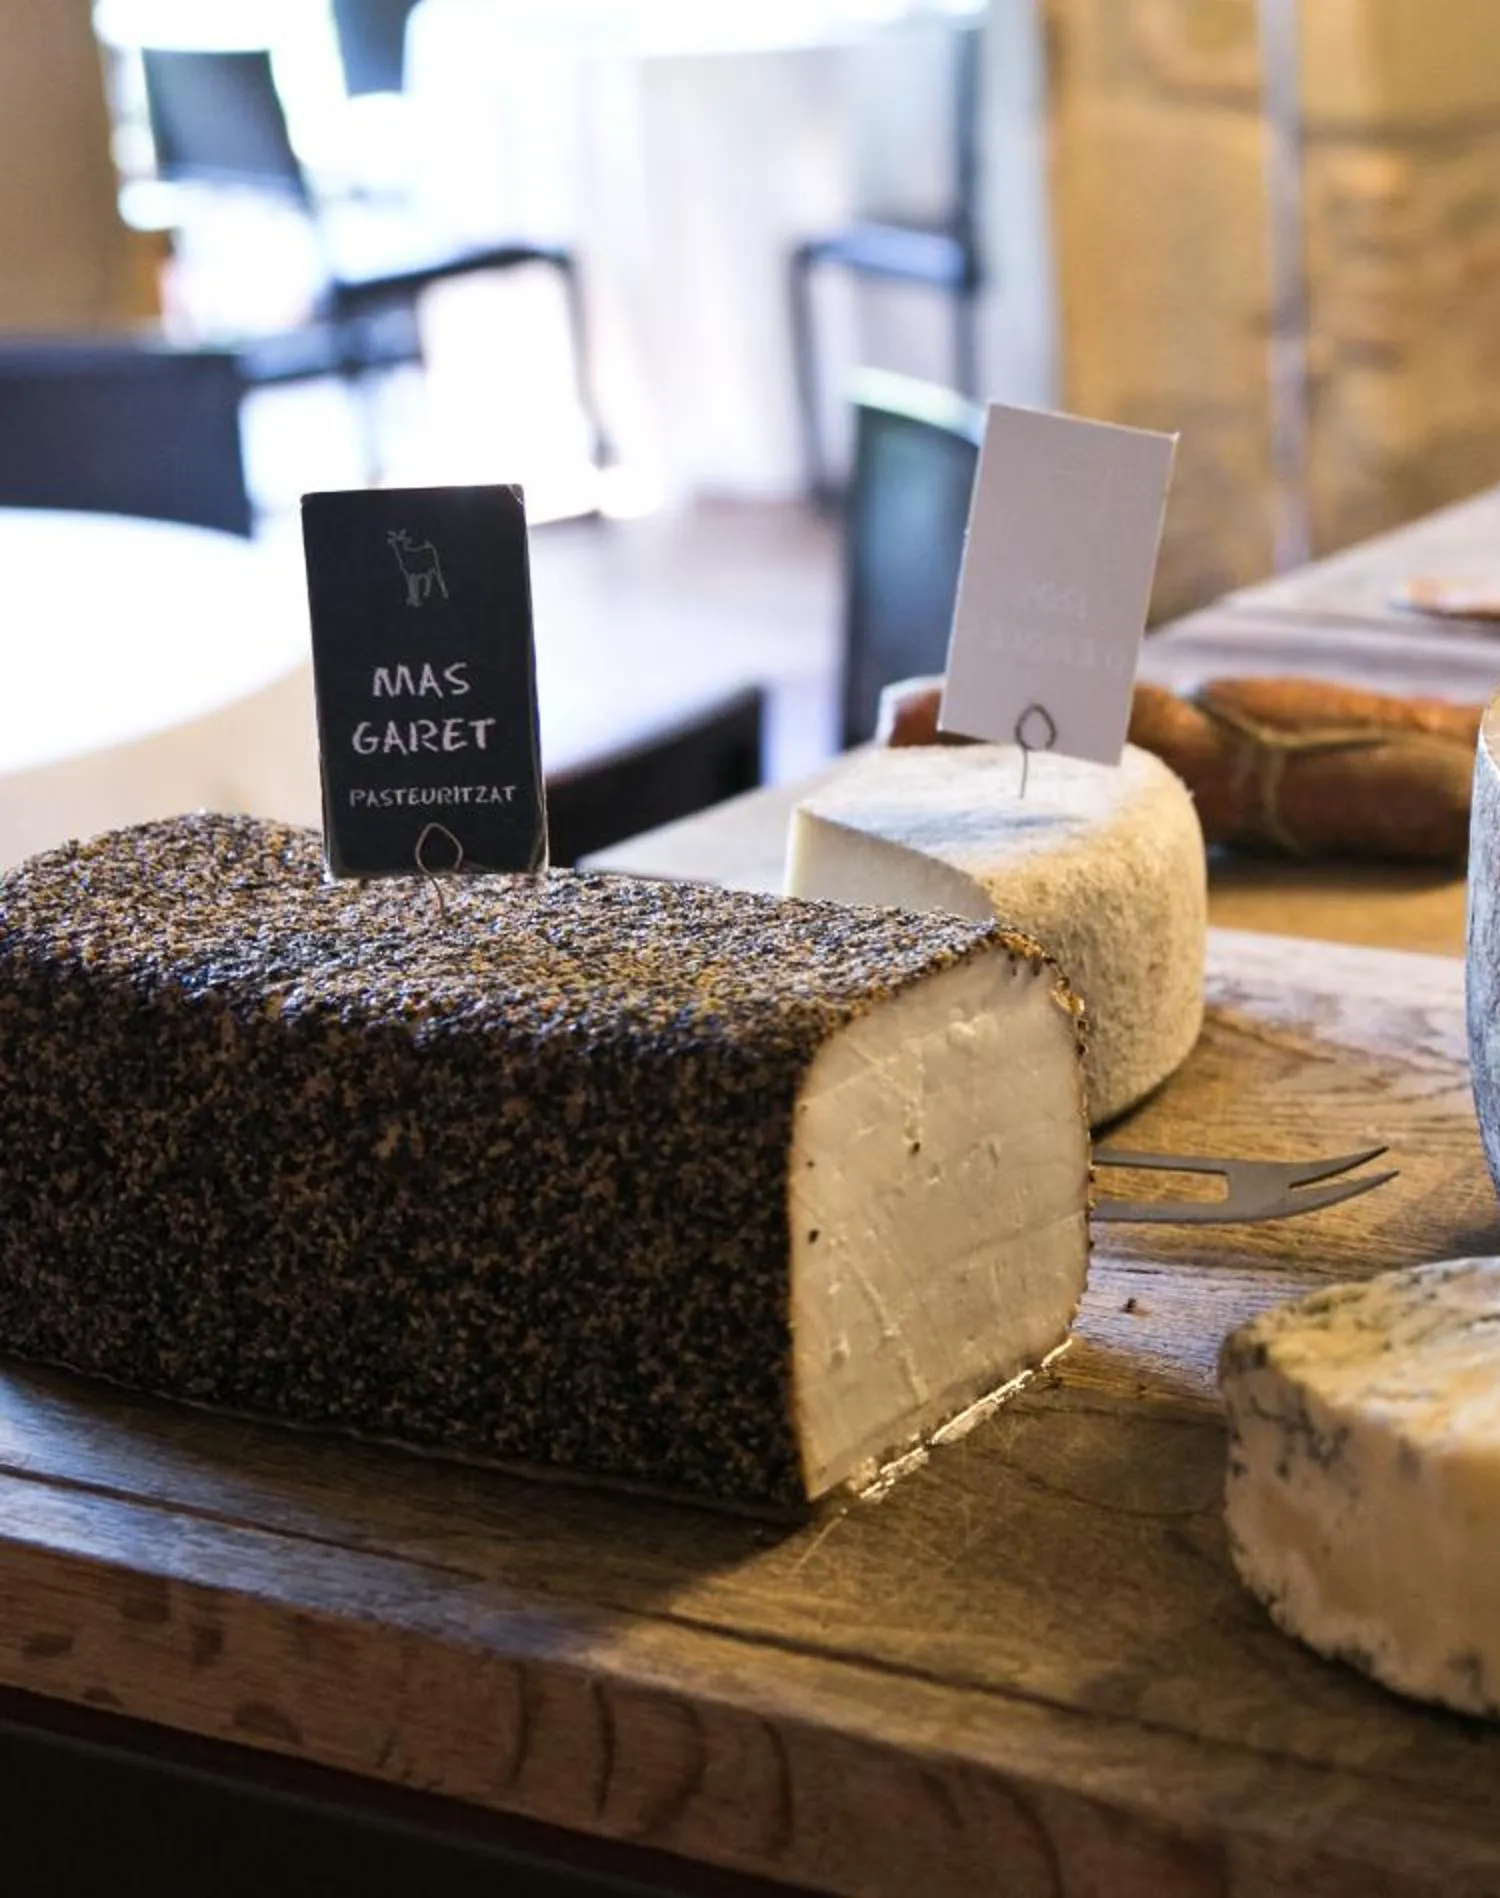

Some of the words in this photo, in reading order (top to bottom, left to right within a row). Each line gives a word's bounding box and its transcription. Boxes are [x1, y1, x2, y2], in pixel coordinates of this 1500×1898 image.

[372, 662, 471, 698] MAS
[352, 718, 497, 755] GARET
[349, 784, 518, 808] PASTEURITZAT
